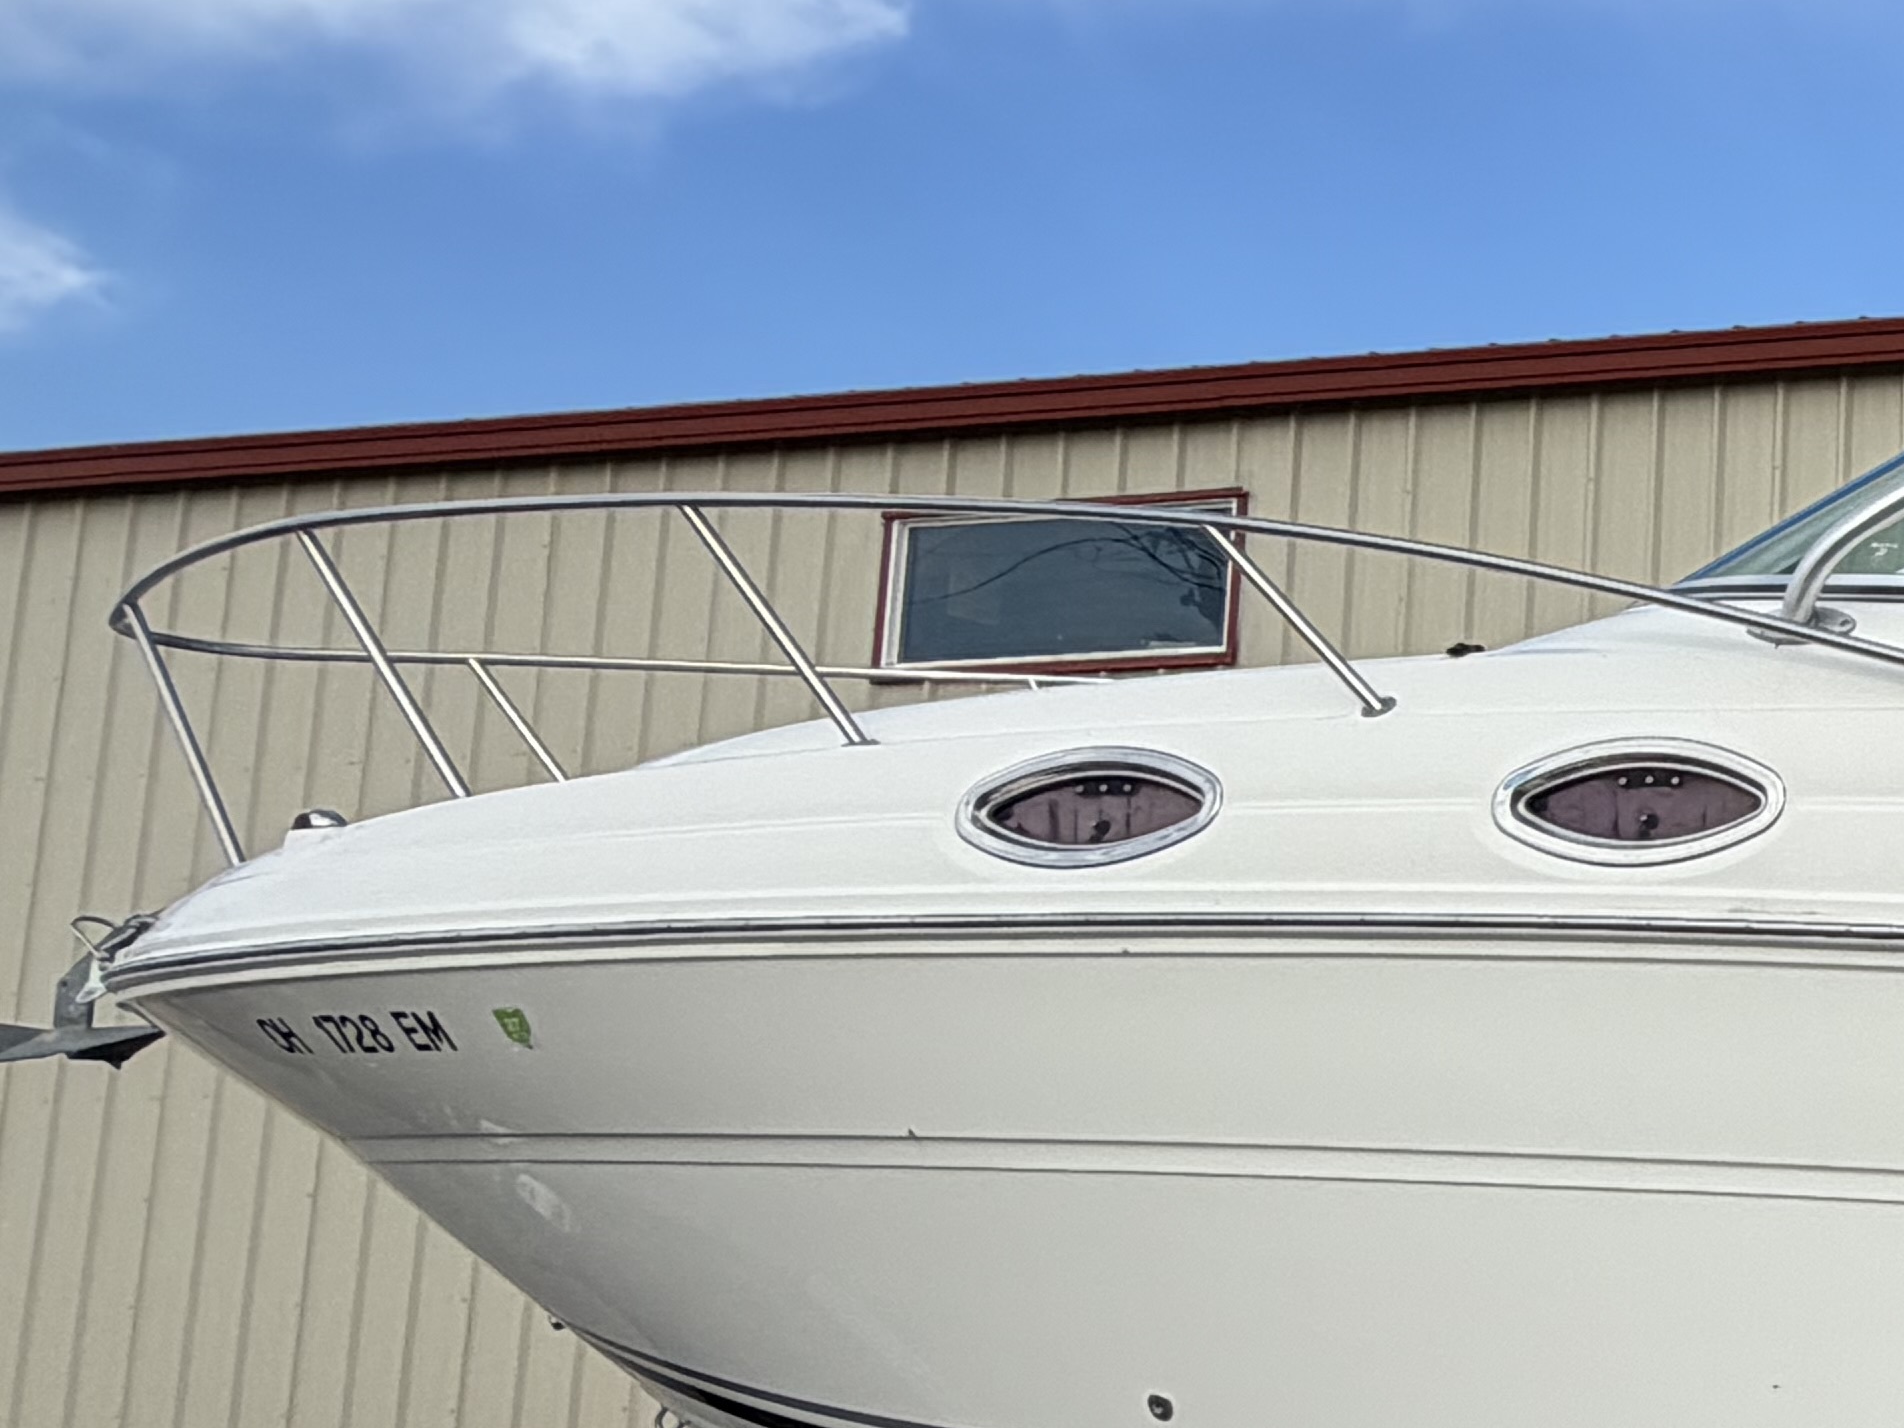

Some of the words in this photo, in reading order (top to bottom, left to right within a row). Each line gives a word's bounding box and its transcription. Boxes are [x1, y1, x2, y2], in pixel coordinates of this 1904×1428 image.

[256, 1016, 315, 1054] OH
[312, 1014, 395, 1053] 1728
[389, 1010, 458, 1052] EM
